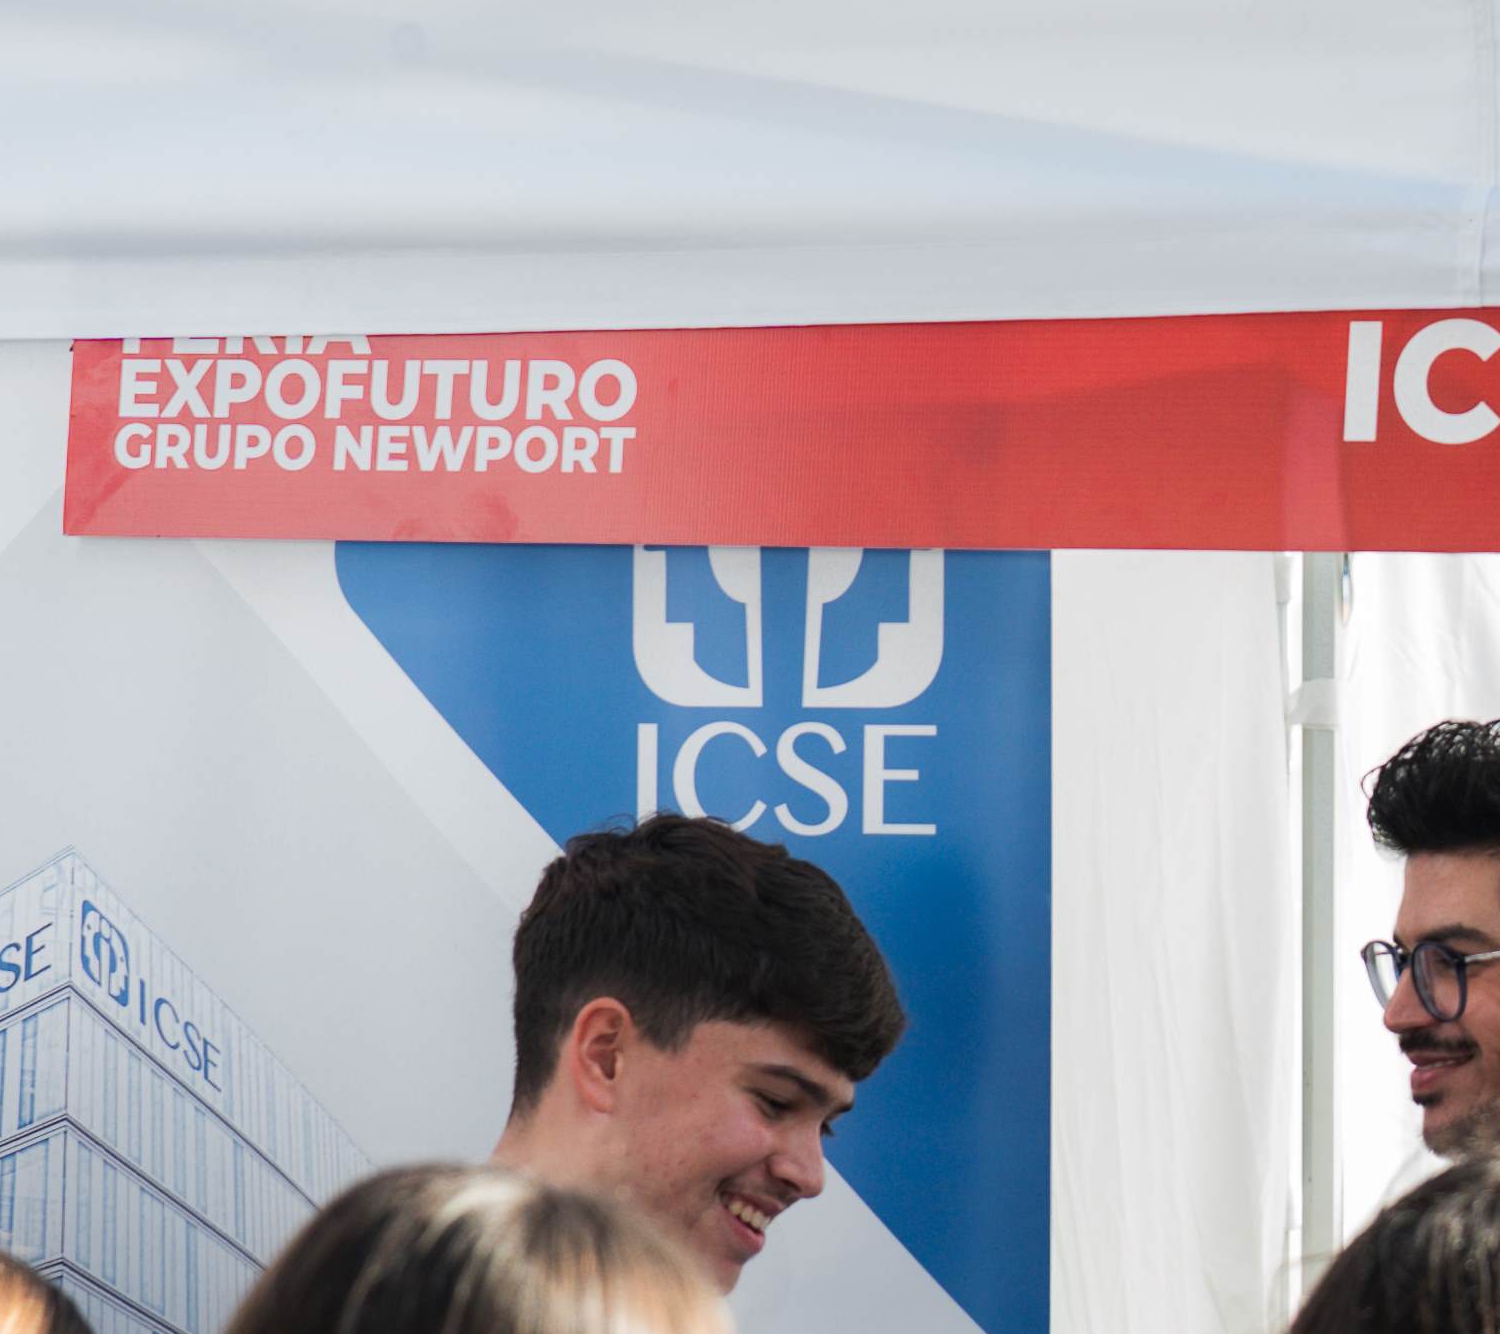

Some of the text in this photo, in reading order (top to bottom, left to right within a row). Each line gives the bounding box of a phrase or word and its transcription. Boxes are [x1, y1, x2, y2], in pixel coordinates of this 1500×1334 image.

[117, 358, 638, 422] EXPOFUTURO
[114, 423, 637, 474] GRUPO NEWPORT
[636, 720, 938, 837] ICSE
[139, 978, 222, 1093] ICSE
